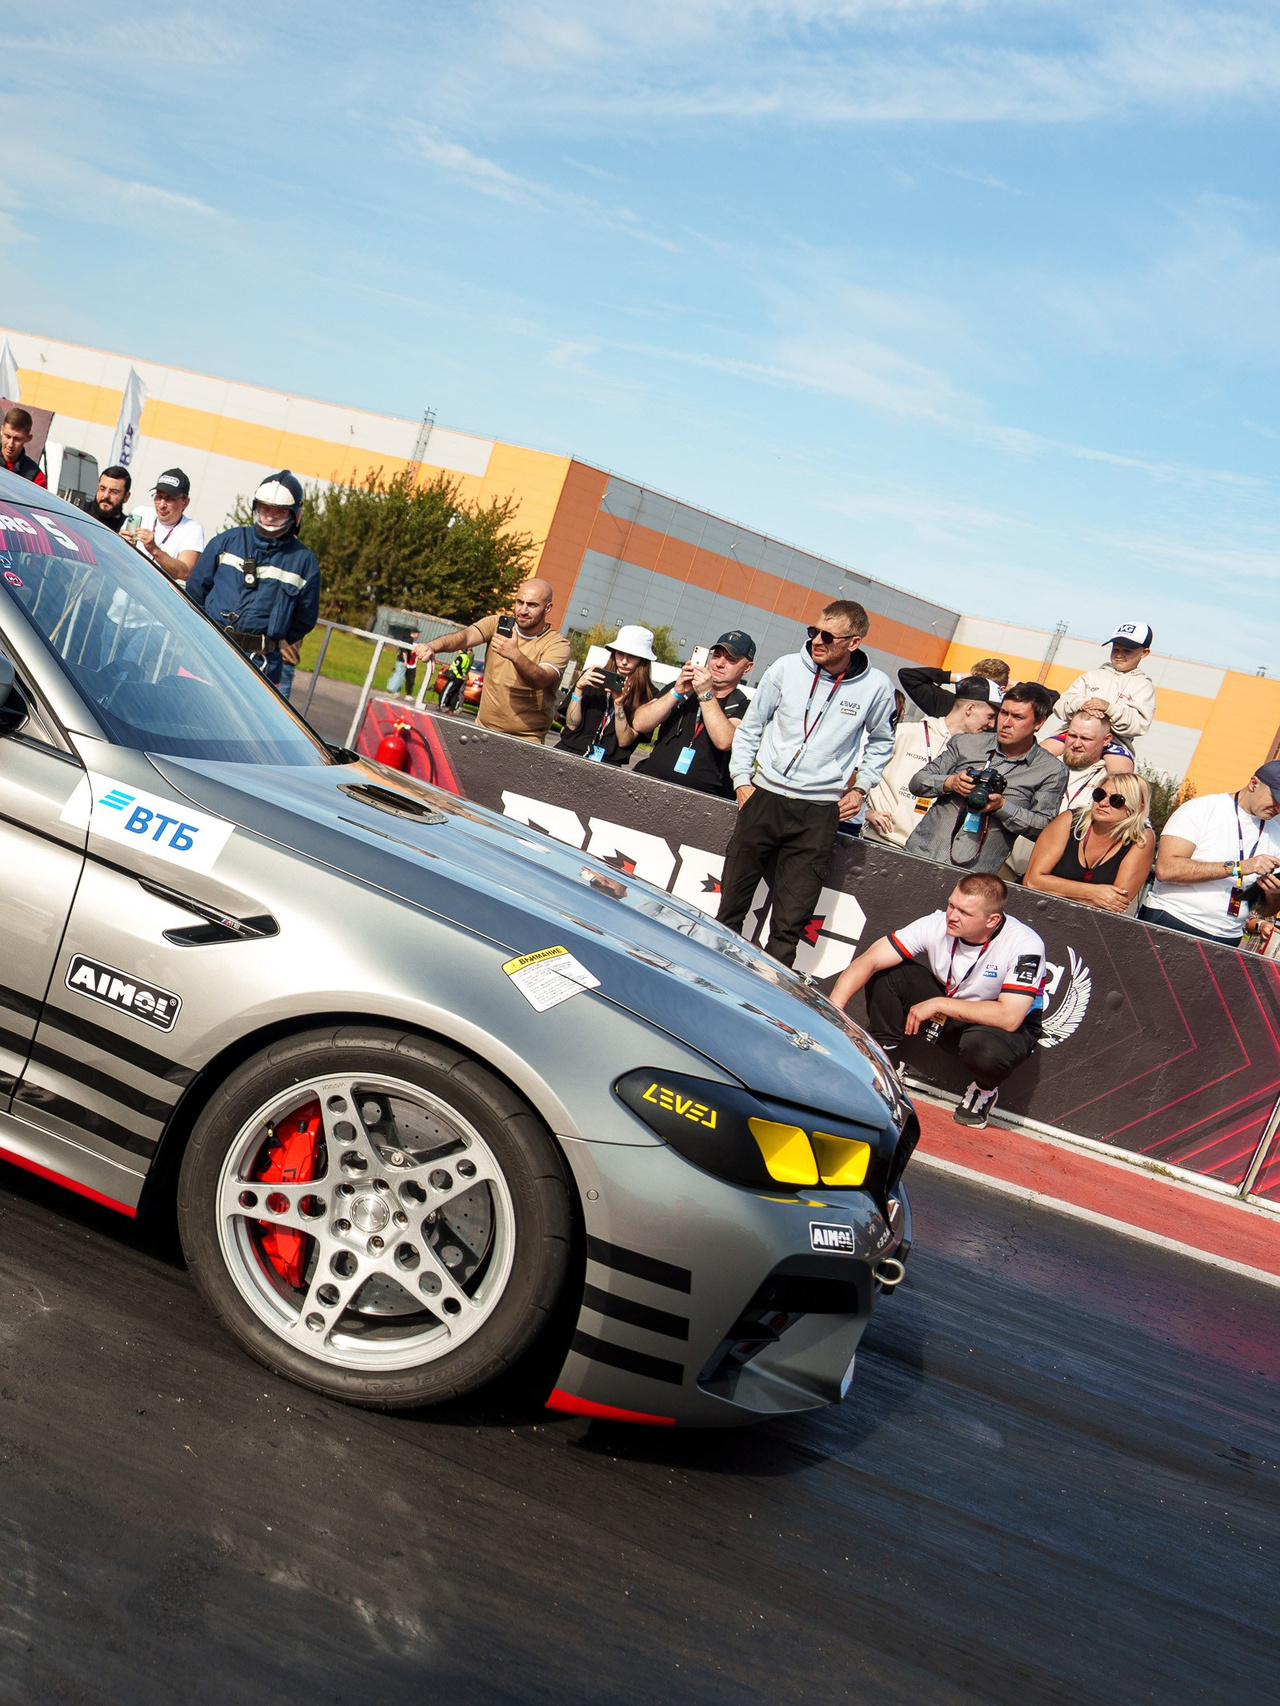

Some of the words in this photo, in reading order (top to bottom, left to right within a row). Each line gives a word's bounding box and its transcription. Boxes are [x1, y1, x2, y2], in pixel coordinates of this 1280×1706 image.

[30, 512, 80, 552] 5
[124, 806, 200, 852] ВТБ
[642, 1083, 717, 1129] LEVEL
